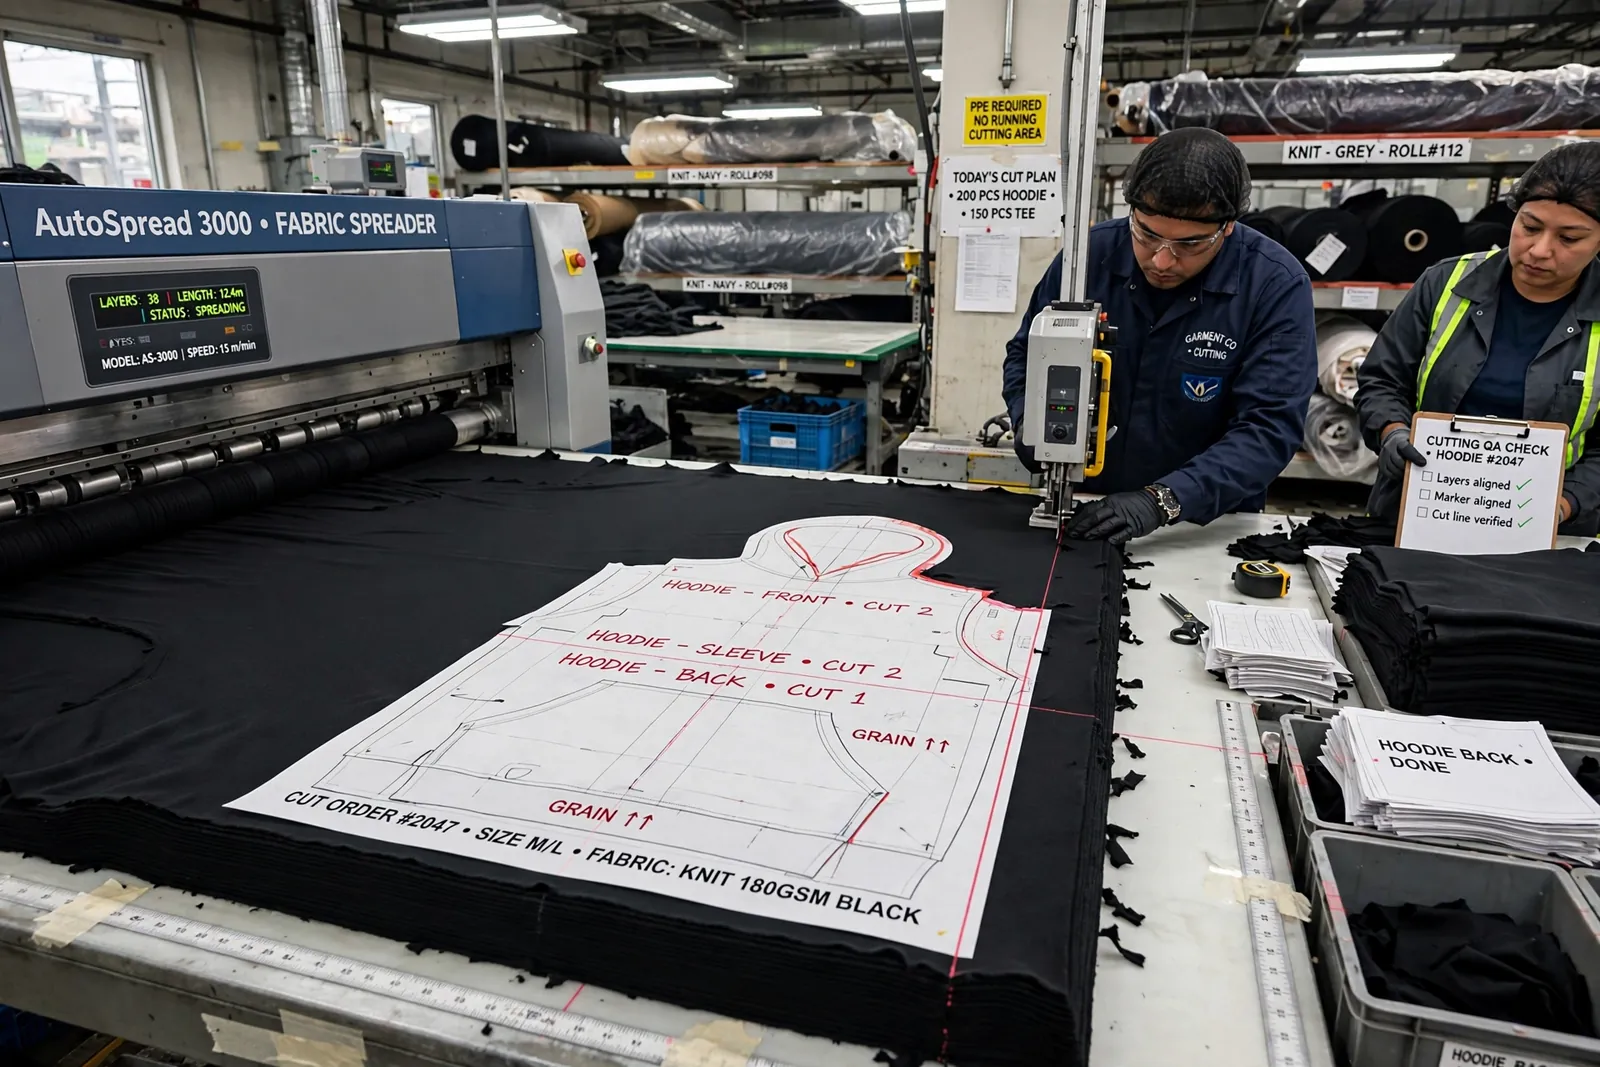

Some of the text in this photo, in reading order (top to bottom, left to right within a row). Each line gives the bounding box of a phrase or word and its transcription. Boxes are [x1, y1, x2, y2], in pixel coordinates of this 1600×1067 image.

[970, 99, 1042, 112] PPE REQUIRED
[973, 113, 1037, 126] NO RUNNING
[968, 128, 1042, 140] CUTTING AREA
[1288, 145, 1322, 159] KNIT
[1335, 144, 1376, 158] GREY
[1389, 144, 1463, 157] ROLL#112
[671, 171, 690, 180] KNIT
[698, 171, 721, 180] NAVY
[730, 170, 774, 180] ROLL#098
[953, 171, 1056, 183] TODAY'S CUT PLAN
[956, 189, 1047, 201] 200 PCS HOODIE
[970, 207, 1035, 219] 150 PCS TEE
[35, 208, 437, 243] AutoSpread 3000 FABRIC SPREADER
[686, 280, 705, 289] KNIT
[713, 280, 736, 289] NAVY
[745, 280, 788, 290] ROLL#098
[99, 295, 142, 309] LAYERS:
[147, 293, 160, 305] 38
[177, 289, 217, 302] LENGTH:
[219, 287, 244, 299] 12.4m
[150, 307, 190, 321] STATUS:
[195, 302, 246, 317] SPREADING
[1185, 331, 1237, 350] GARMENT CO
[101, 355, 141, 370] MODEL:
[142, 350, 179, 365] AS-3000
[187, 344, 219, 358] SPEED:
[219, 343, 230, 354] 15
[230, 340, 257, 353] m/min
[1193, 347, 1227, 360] CUTTING
[1427, 435, 1550, 456] CUTTING QA CHECK
[1436, 449, 1525, 467] HOODIE #2047
[1437, 473, 1511, 491] Layers aligned
[1434, 491, 1512, 509] Marker aligned
[1432, 509, 1513, 528] Cut line verified
[662, 579, 737, 595] HOODIE
[761, 590, 836, 606] FRONT
[863, 601, 910, 613] CUT
[917, 606, 934, 617] 2
[586, 629, 670, 649] HOODIE
[696, 643, 791, 665] SLEEVE
[822, 659, 875, 676] CUT
[884, 667, 903, 680] 2
[558, 652, 647, 675] HOODIE
[675, 668, 747, 688] BACK
[787, 683, 843, 701] CUT
[850, 692, 866, 705] 1
[852, 728, 915, 747] GRAIN
[1378, 739, 1520, 766] HOODIE BACK
[1389, 756, 1451, 774] DONE
[548, 799, 618, 823] GRAIN
[283, 790, 922, 925] CUT ORDER #2047 SIZE M/L FABRIC: KNIT 180GSM BLACK
[1452, 1048, 1507, 1067] HOODIE
